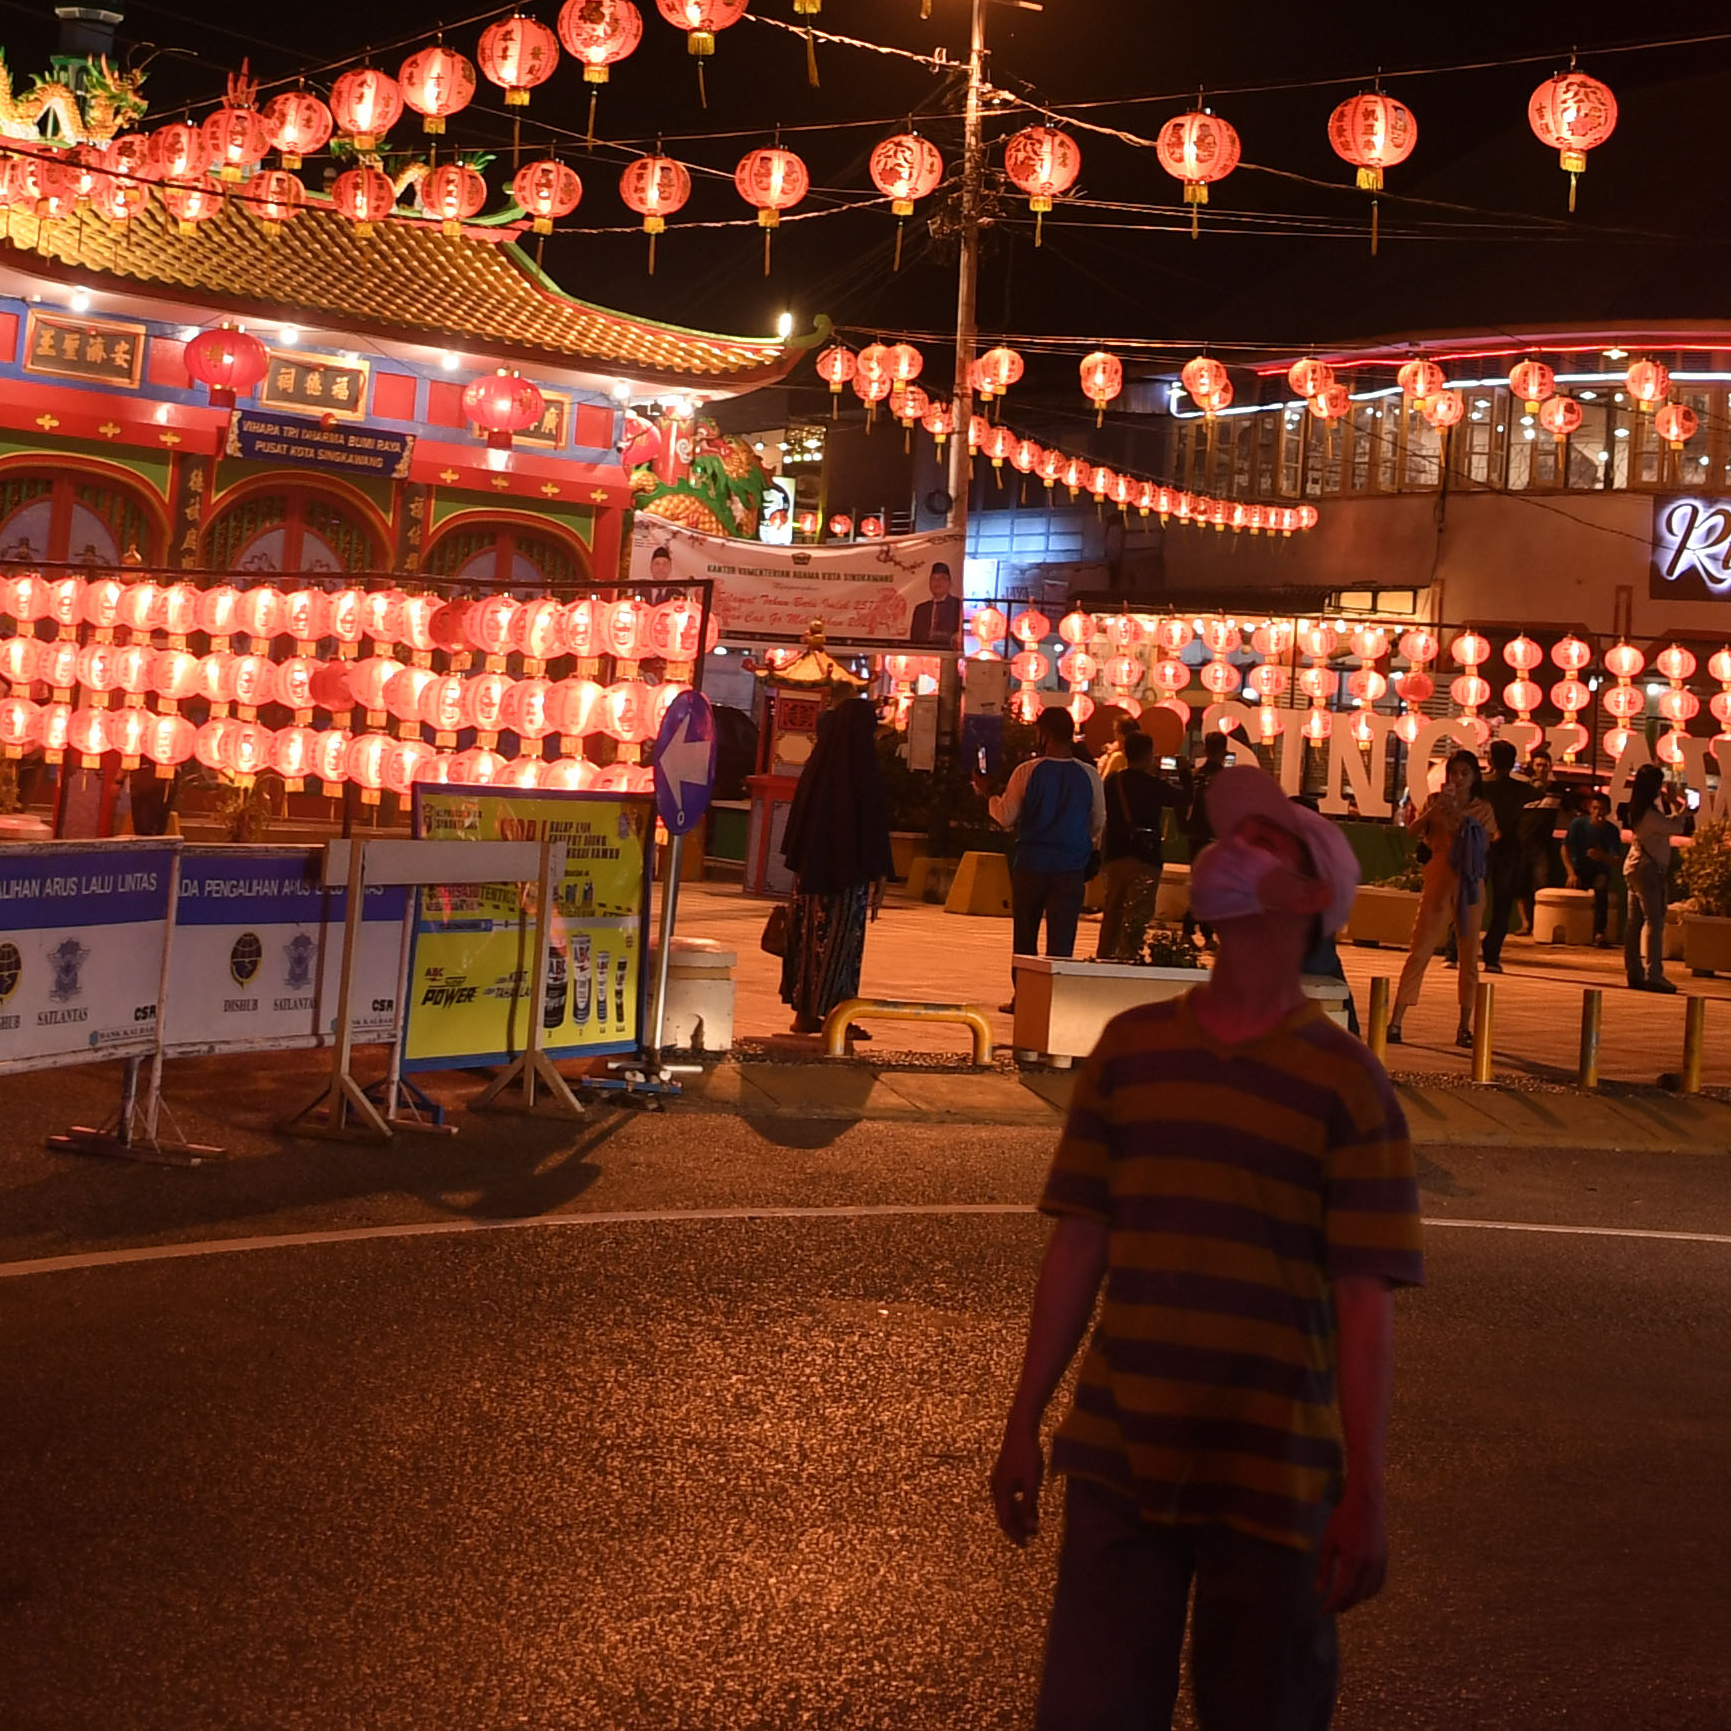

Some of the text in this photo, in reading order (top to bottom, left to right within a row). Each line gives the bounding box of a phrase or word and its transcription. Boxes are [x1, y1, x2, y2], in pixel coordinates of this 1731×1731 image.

[243, 420, 402, 453] VIHARA TRI DHARMA BUMI RAYA
[255, 440, 384, 469] PUSAT KOTA SINGKAWANG
[707, 565, 736, 574] KANTOR
[43, 876, 78, 898] ARUS
[82, 875, 113, 894] LALU
[118, 872, 158, 892] LINTAS
[205, 879, 279, 898] PENGALIHAN
[223, 998, 259, 1012] DISHUB
[273, 997, 317, 1011] SATLANTA
[372, 999, 394, 1012] CSR
[421, 987, 484, 1009] POWER
[37, 1007, 89, 1027] SATLANTAS
[134, 1005, 157, 1021] CSR
